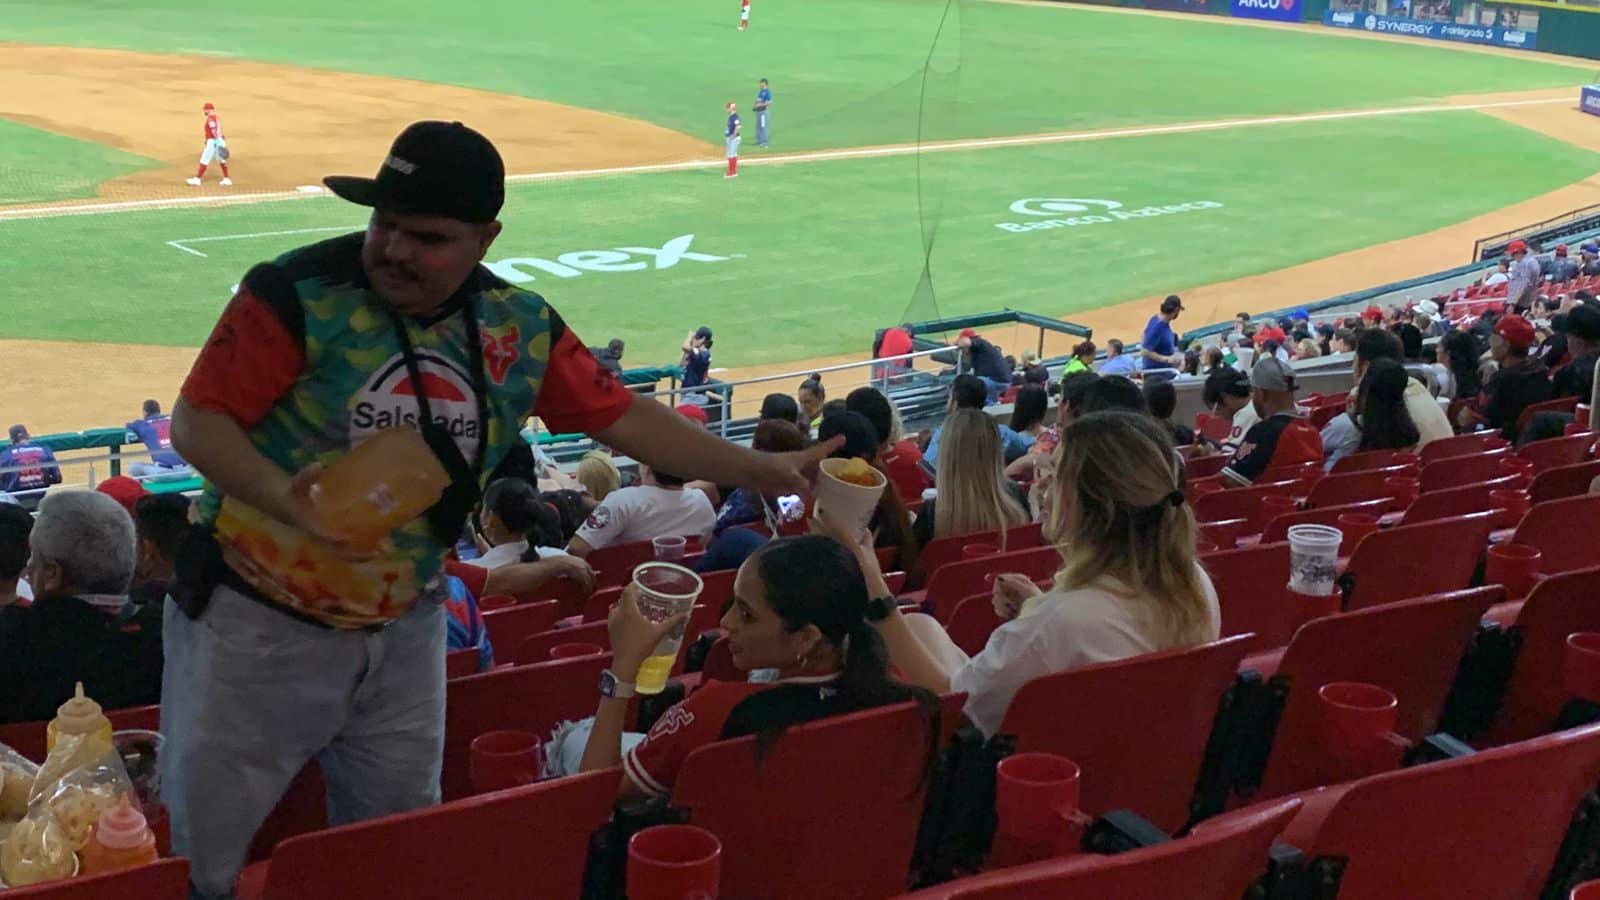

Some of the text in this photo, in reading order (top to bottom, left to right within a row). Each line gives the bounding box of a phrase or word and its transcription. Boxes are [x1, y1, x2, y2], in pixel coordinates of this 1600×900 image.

[1377, 19, 1433, 34] SYNERGY
[995, 200, 1223, 233] Banco Azteca
